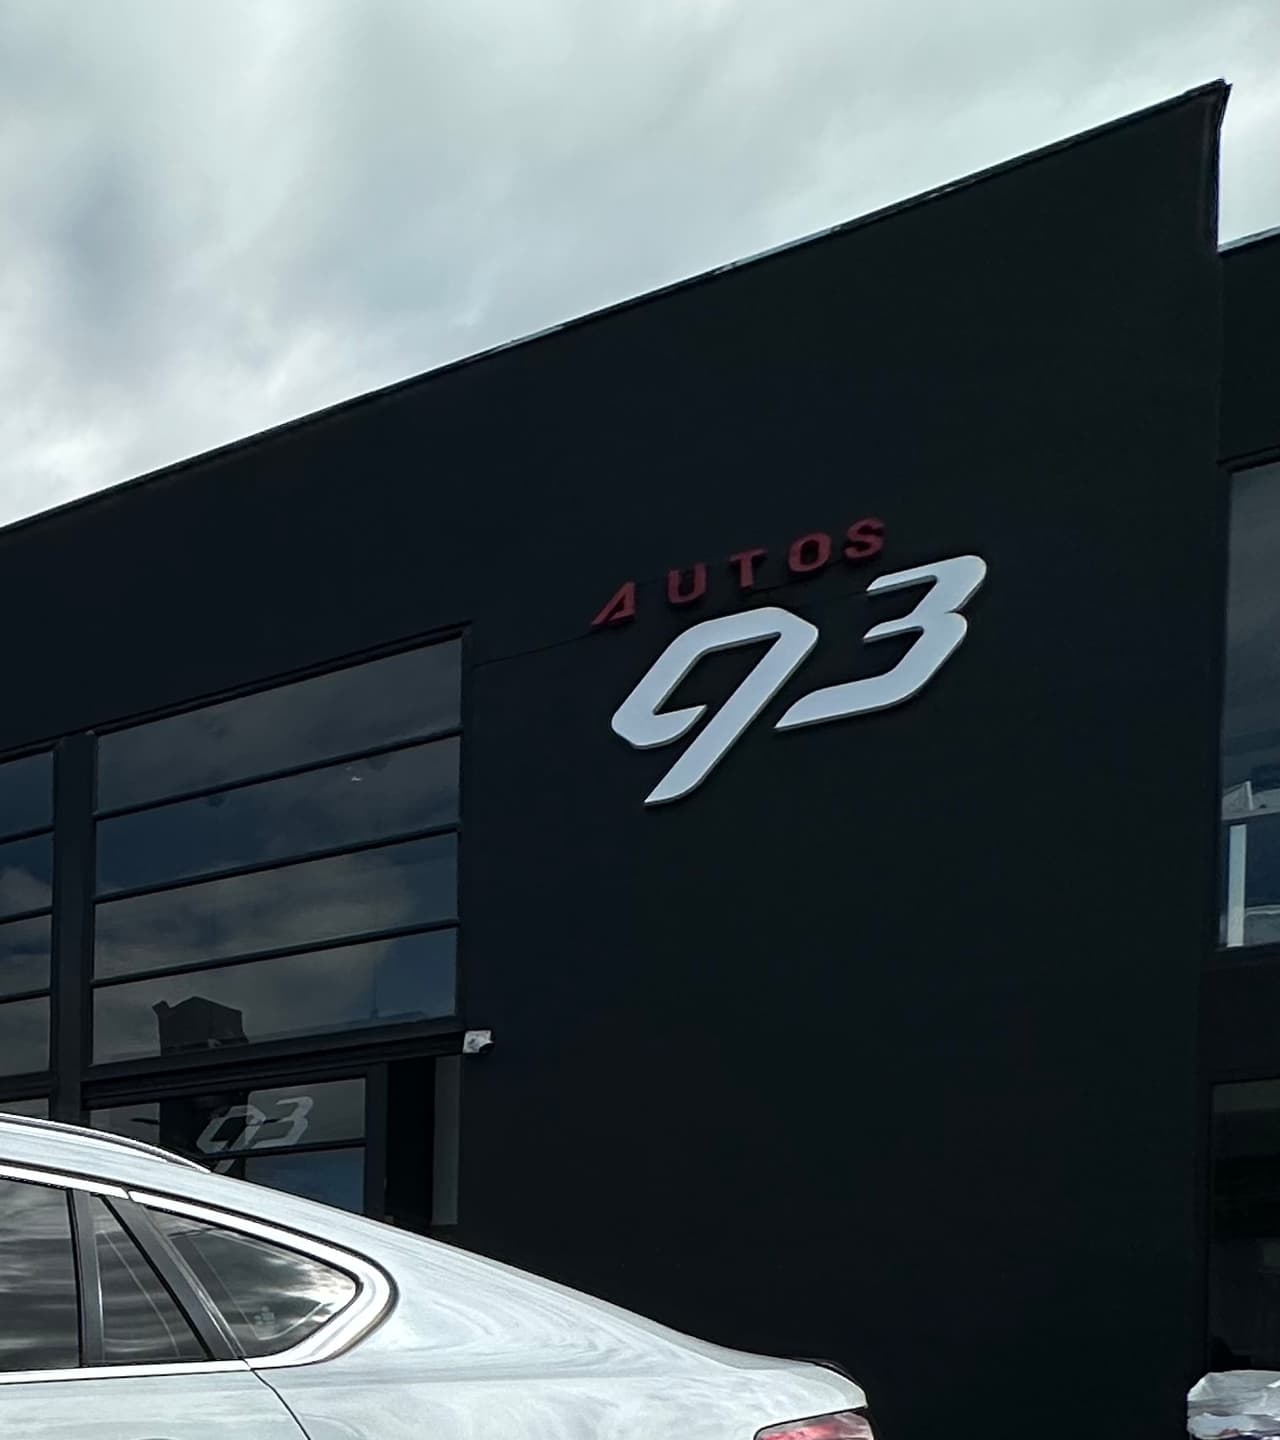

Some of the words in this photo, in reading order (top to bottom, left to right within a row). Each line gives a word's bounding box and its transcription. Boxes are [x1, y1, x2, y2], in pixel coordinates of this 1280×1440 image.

[591, 517, 887, 630] AUTOS
[611, 554, 987, 806] 93
[196, 1096, 313, 1174] 93
